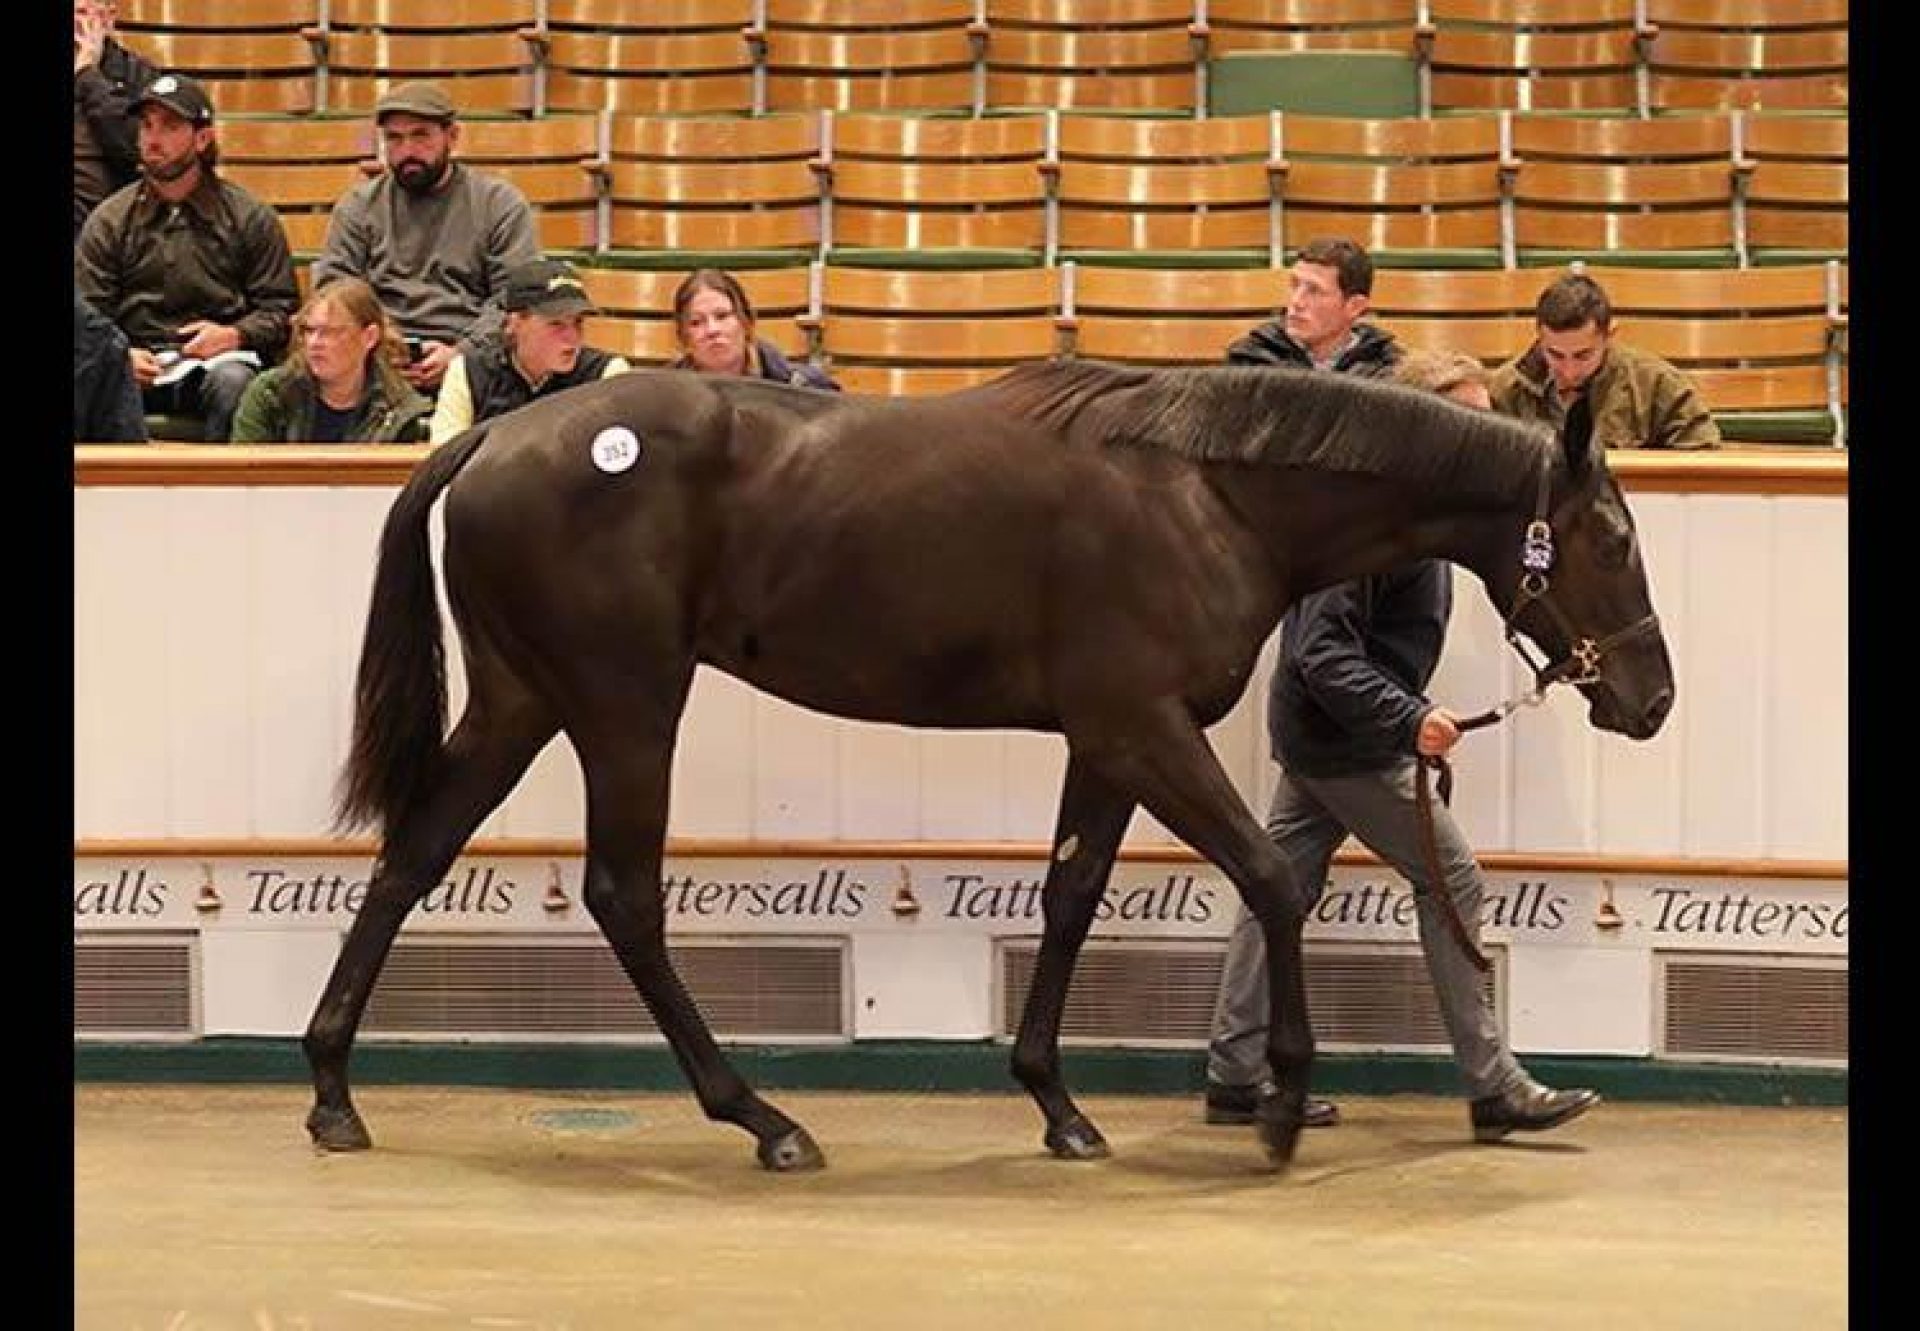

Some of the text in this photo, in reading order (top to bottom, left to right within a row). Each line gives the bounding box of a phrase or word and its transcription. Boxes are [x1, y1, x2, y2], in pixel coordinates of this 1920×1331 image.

[247, 868, 516, 914] Tattealls
[662, 869, 866, 916] ttersalls
[944, 874, 1214, 921] Tattsalls
